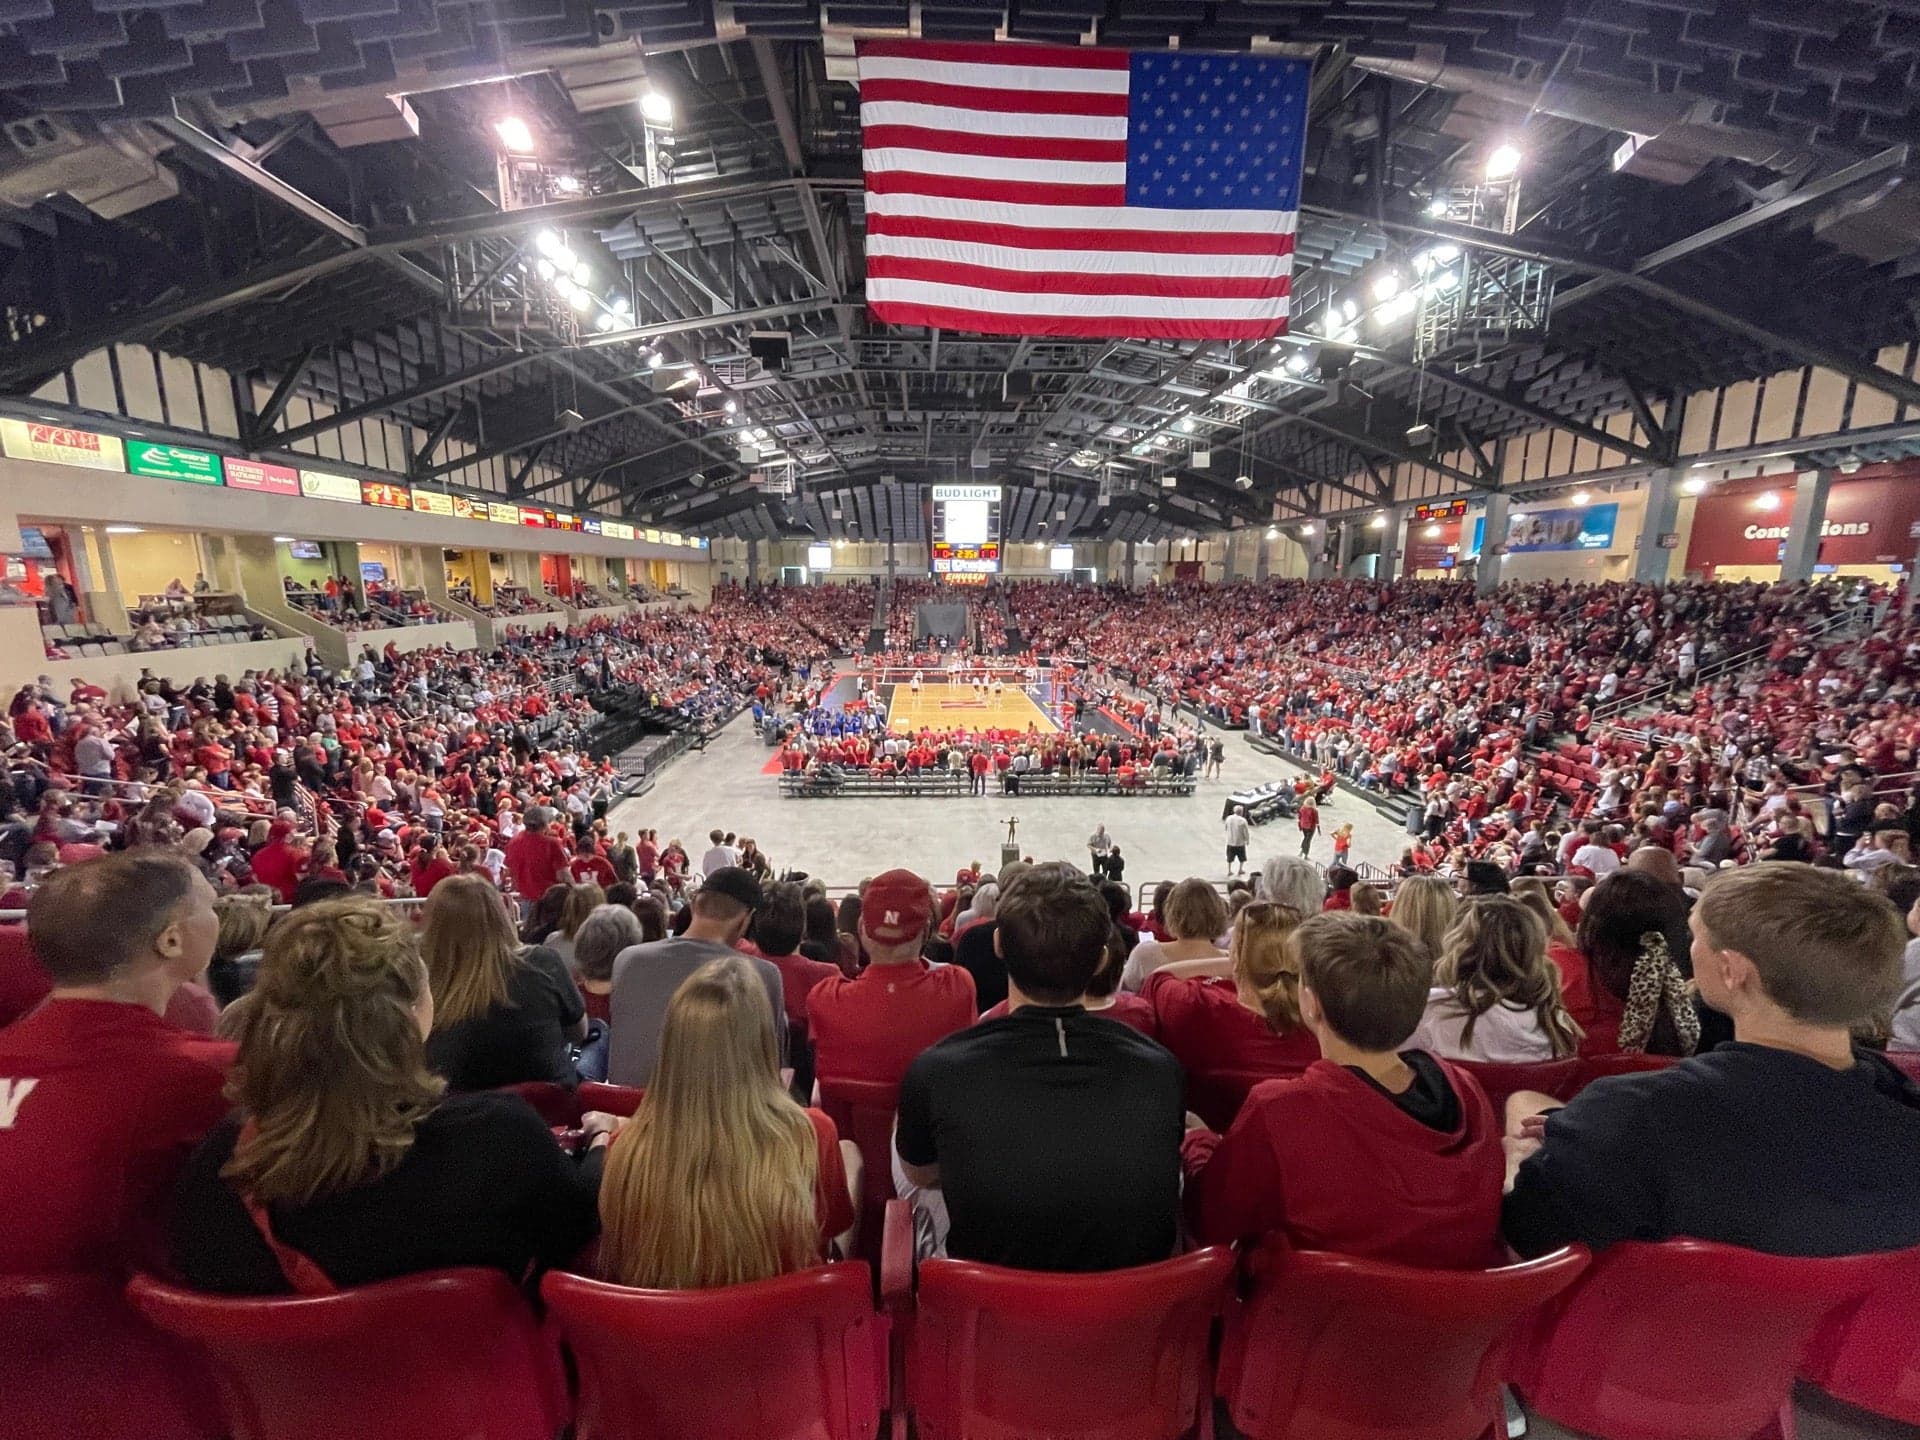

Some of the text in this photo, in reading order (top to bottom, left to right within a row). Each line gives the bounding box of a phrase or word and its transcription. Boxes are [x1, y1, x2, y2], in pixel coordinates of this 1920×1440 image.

[935, 488, 998, 498] BUD LIGHT
[1744, 519, 1870, 540] Concions
[883, 909, 900, 925] N
